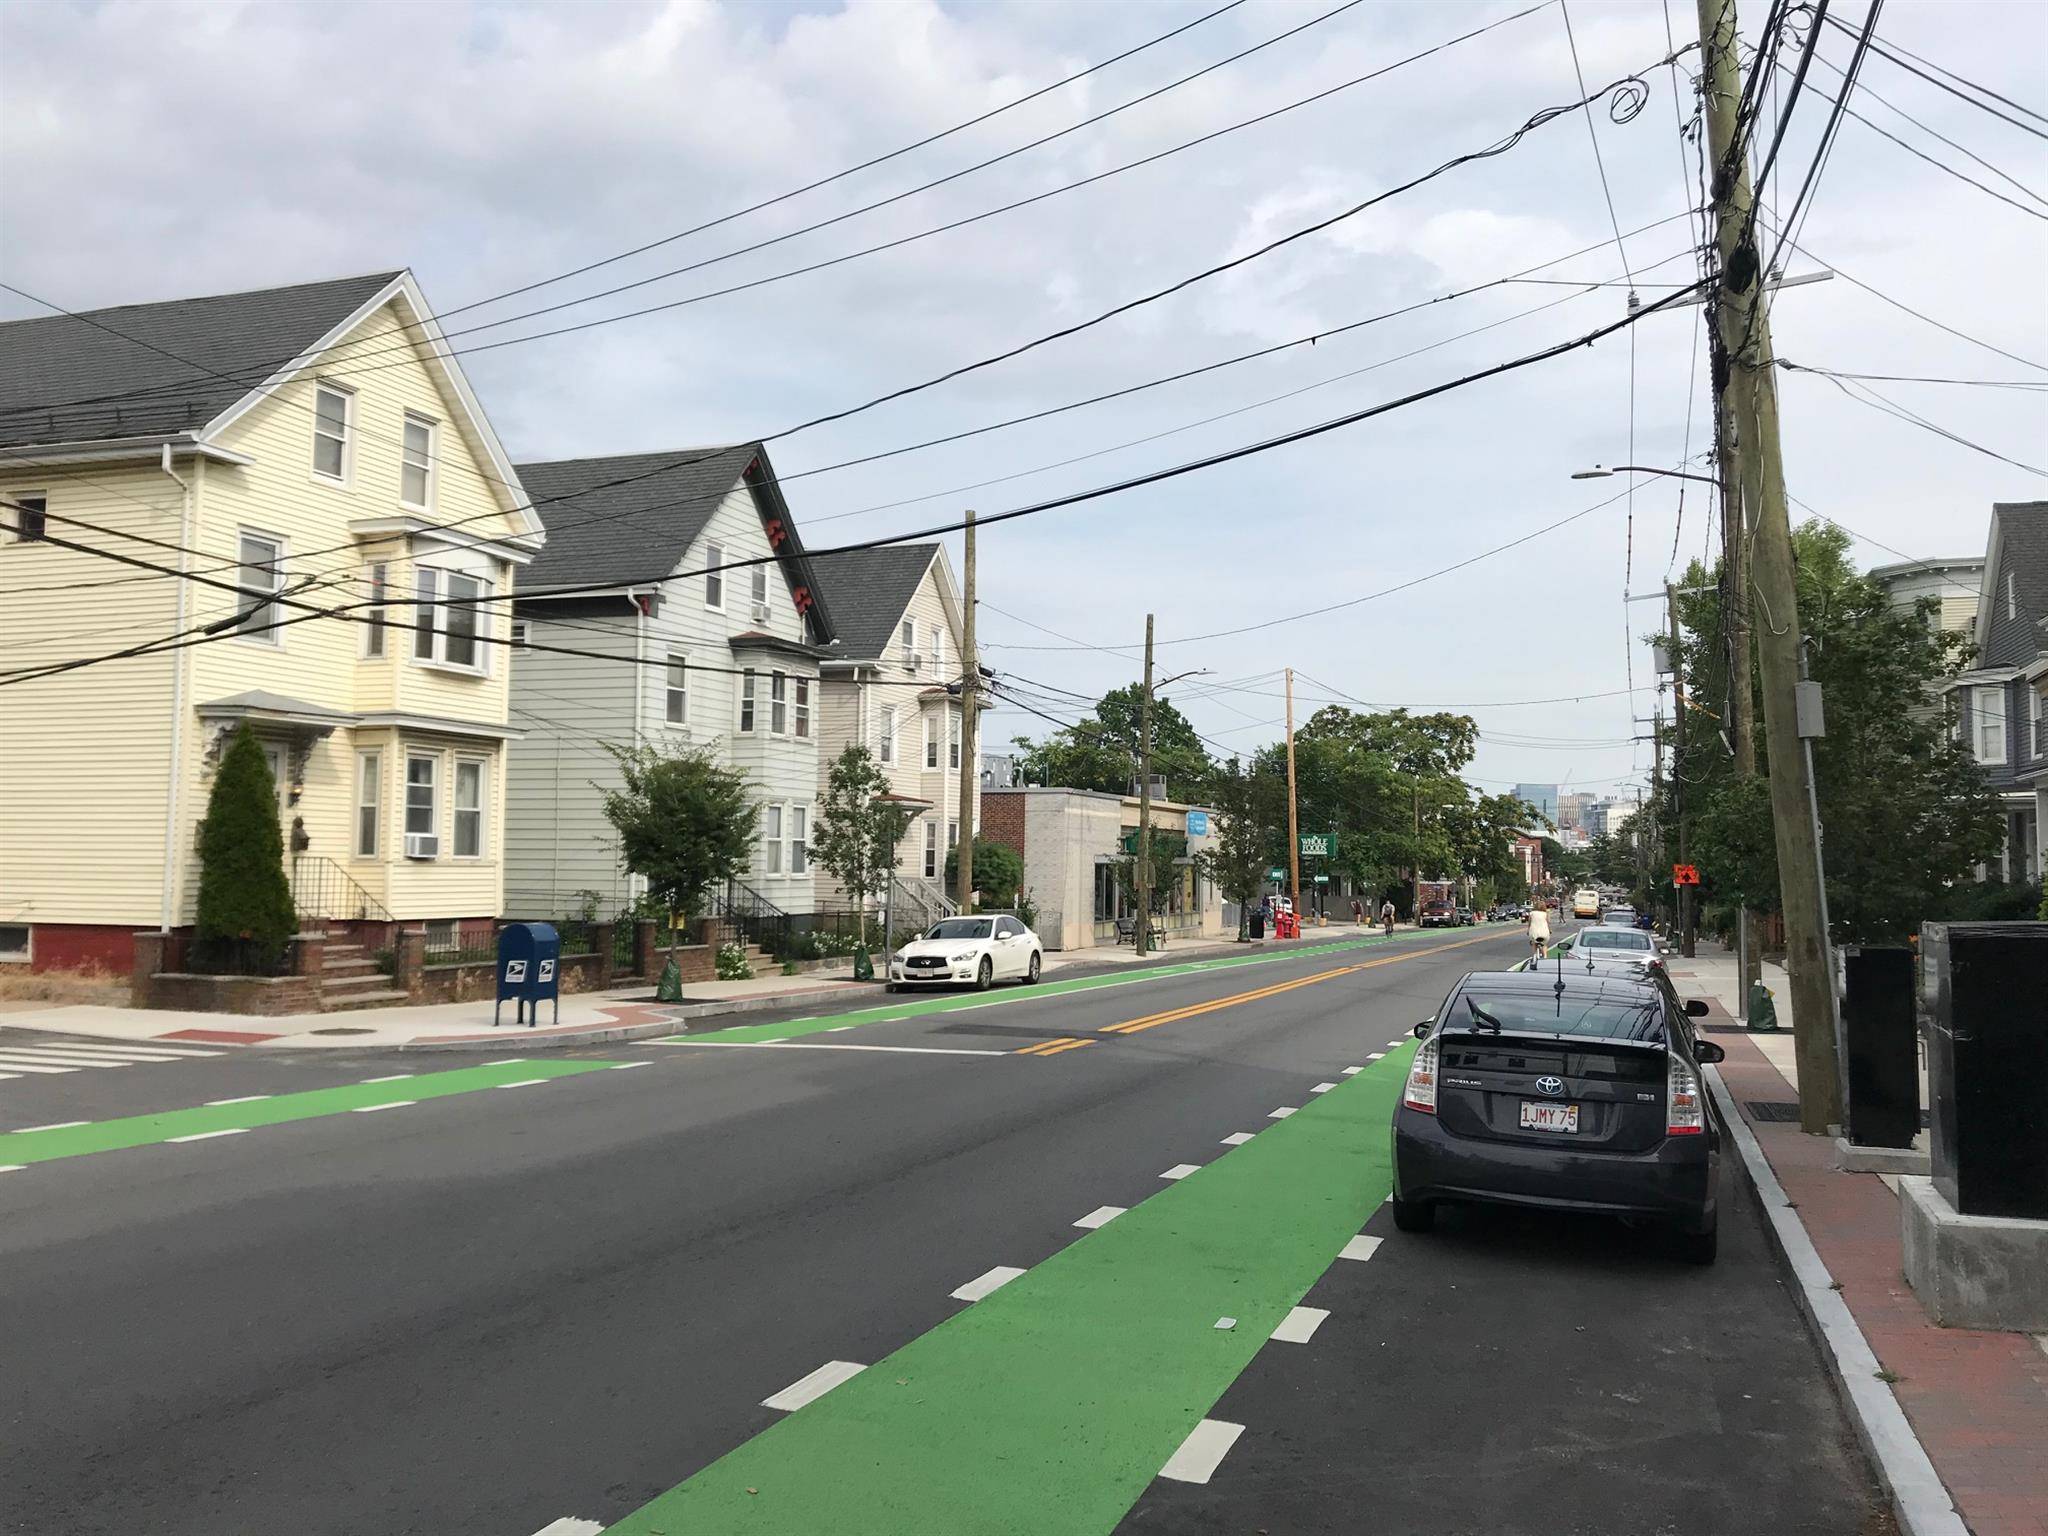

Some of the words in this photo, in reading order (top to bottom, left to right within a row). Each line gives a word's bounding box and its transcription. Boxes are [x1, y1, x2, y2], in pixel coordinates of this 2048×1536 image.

[1300, 837, 1328, 845] WHOLE
[1521, 1107, 1555, 1124] 1JMY
[1559, 1110, 1577, 1127] 75
